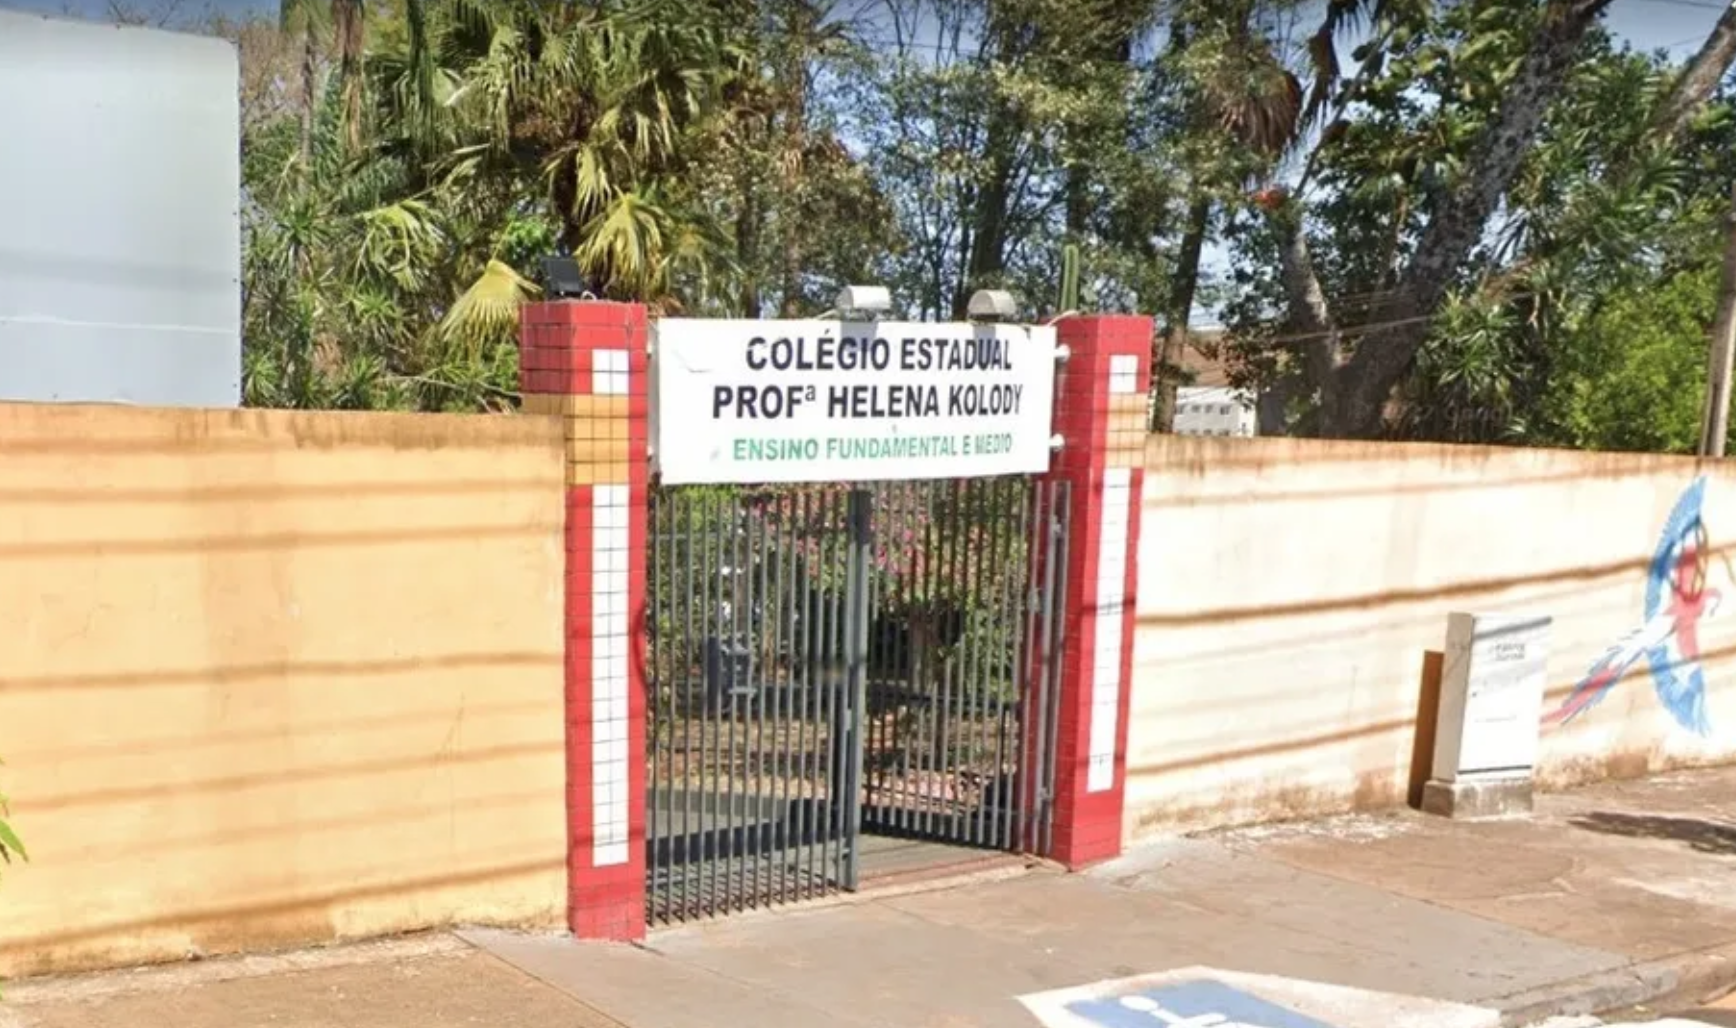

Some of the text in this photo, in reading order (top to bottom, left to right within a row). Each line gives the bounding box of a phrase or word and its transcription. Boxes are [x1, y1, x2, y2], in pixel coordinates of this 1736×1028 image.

[746, 329, 1012, 371] COLÉGIO ESTADUAL
[828, 385, 939, 418] HELENA
[948, 383, 1023, 416] KOLODY
[733, 438, 819, 461] ENSINO
[826, 436, 958, 460] FUNDAMENTAL
[962, 435, 971, 455] E
